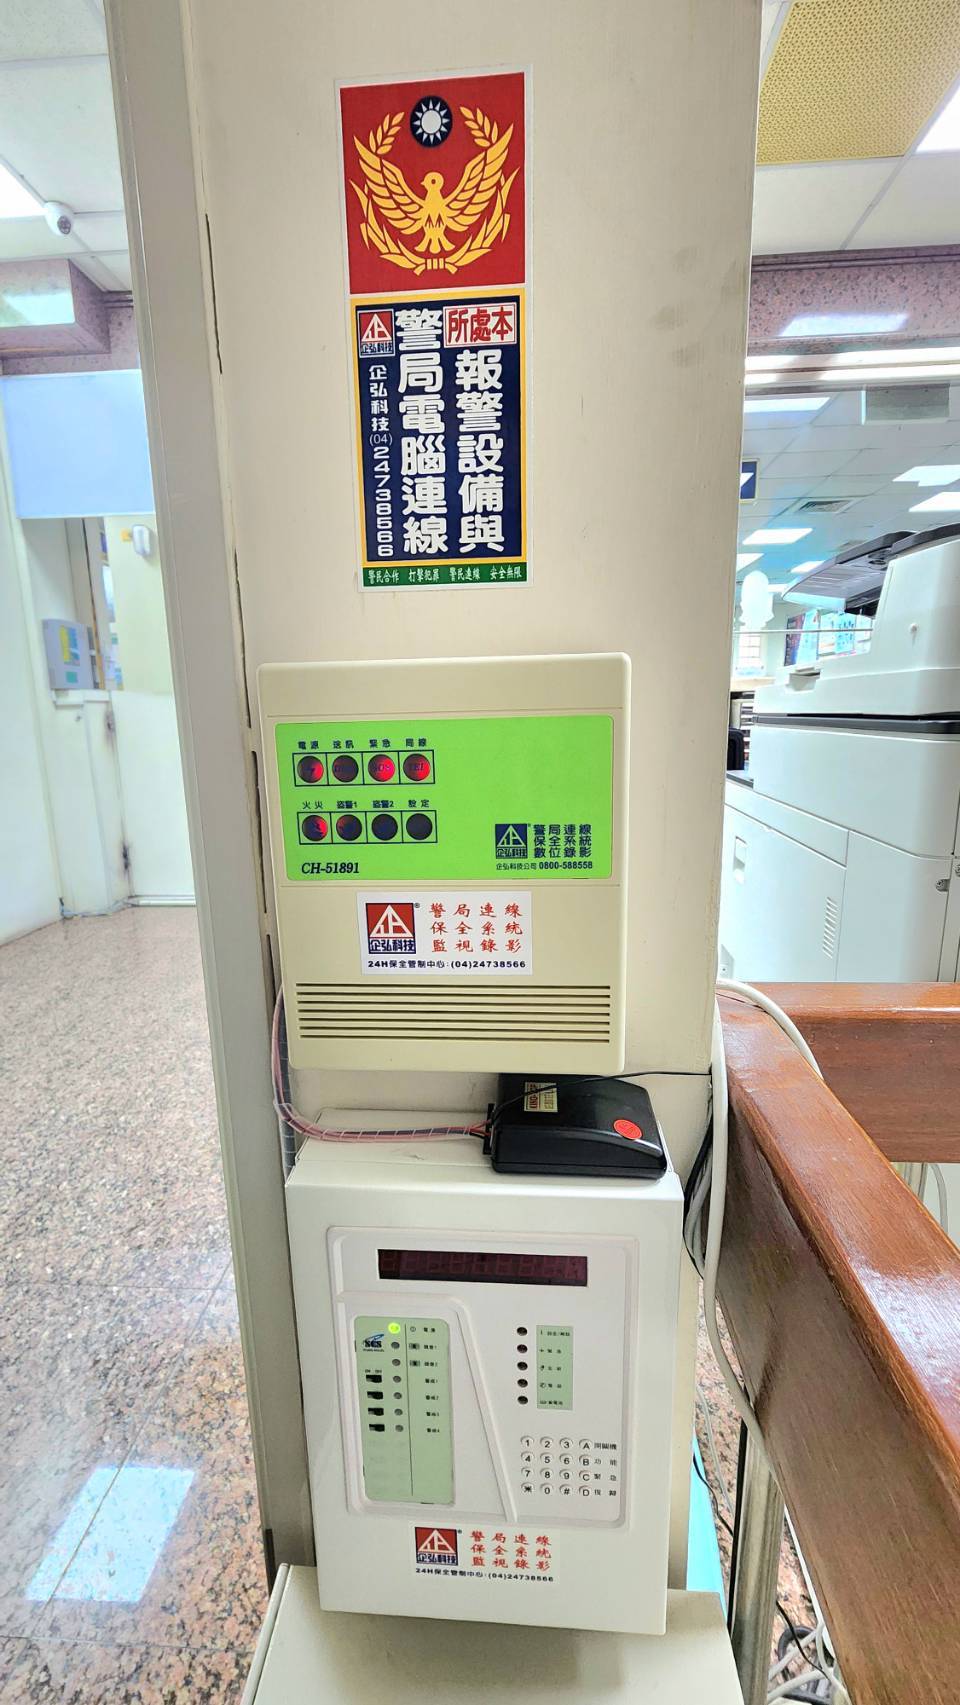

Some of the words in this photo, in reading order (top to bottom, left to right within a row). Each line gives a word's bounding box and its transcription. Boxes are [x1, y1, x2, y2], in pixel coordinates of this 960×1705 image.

[395, 308, 449, 554] 警局電腦連線
[455, 349, 504, 553] 報警設備與
[367, 568, 400, 584] 警民合作
[407, 567, 440, 583] 打擊犯罪
[448, 566, 481, 581] 警民連線
[489, 565, 522, 580] 安全無限
[533, 824, 592, 836] 警局連線
[534, 835, 592, 847] 保全系統
[301, 862, 360, 874] CH-51891
[539, 861, 593, 870] 0800-588558
[429, 902, 523, 918] 警局連線
[430, 921, 524, 936] 保全系統
[370, 939, 415, 952] 企弘科技
[431, 938, 522, 954] 監視錄影
[525, 1439, 530, 1447] 1
[544, 1440, 550, 1448] 2
[563, 1441, 570, 1449] 3
[583, 1442, 590, 1450] A
[544, 1456, 550, 1464] 5
[563, 1457, 570, 1465] 6
[583, 1458, 590, 1466] B
[544, 1471, 551, 1479] 8
[563, 1472, 570, 1480] 9
[582, 1473, 590, 1481] C
[563, 1487, 570, 1495] #
[582, 1488, 590, 1497] D
[470, 1530, 552, 1546] 警局連線
[470, 1544, 552, 1559] 保全系統
